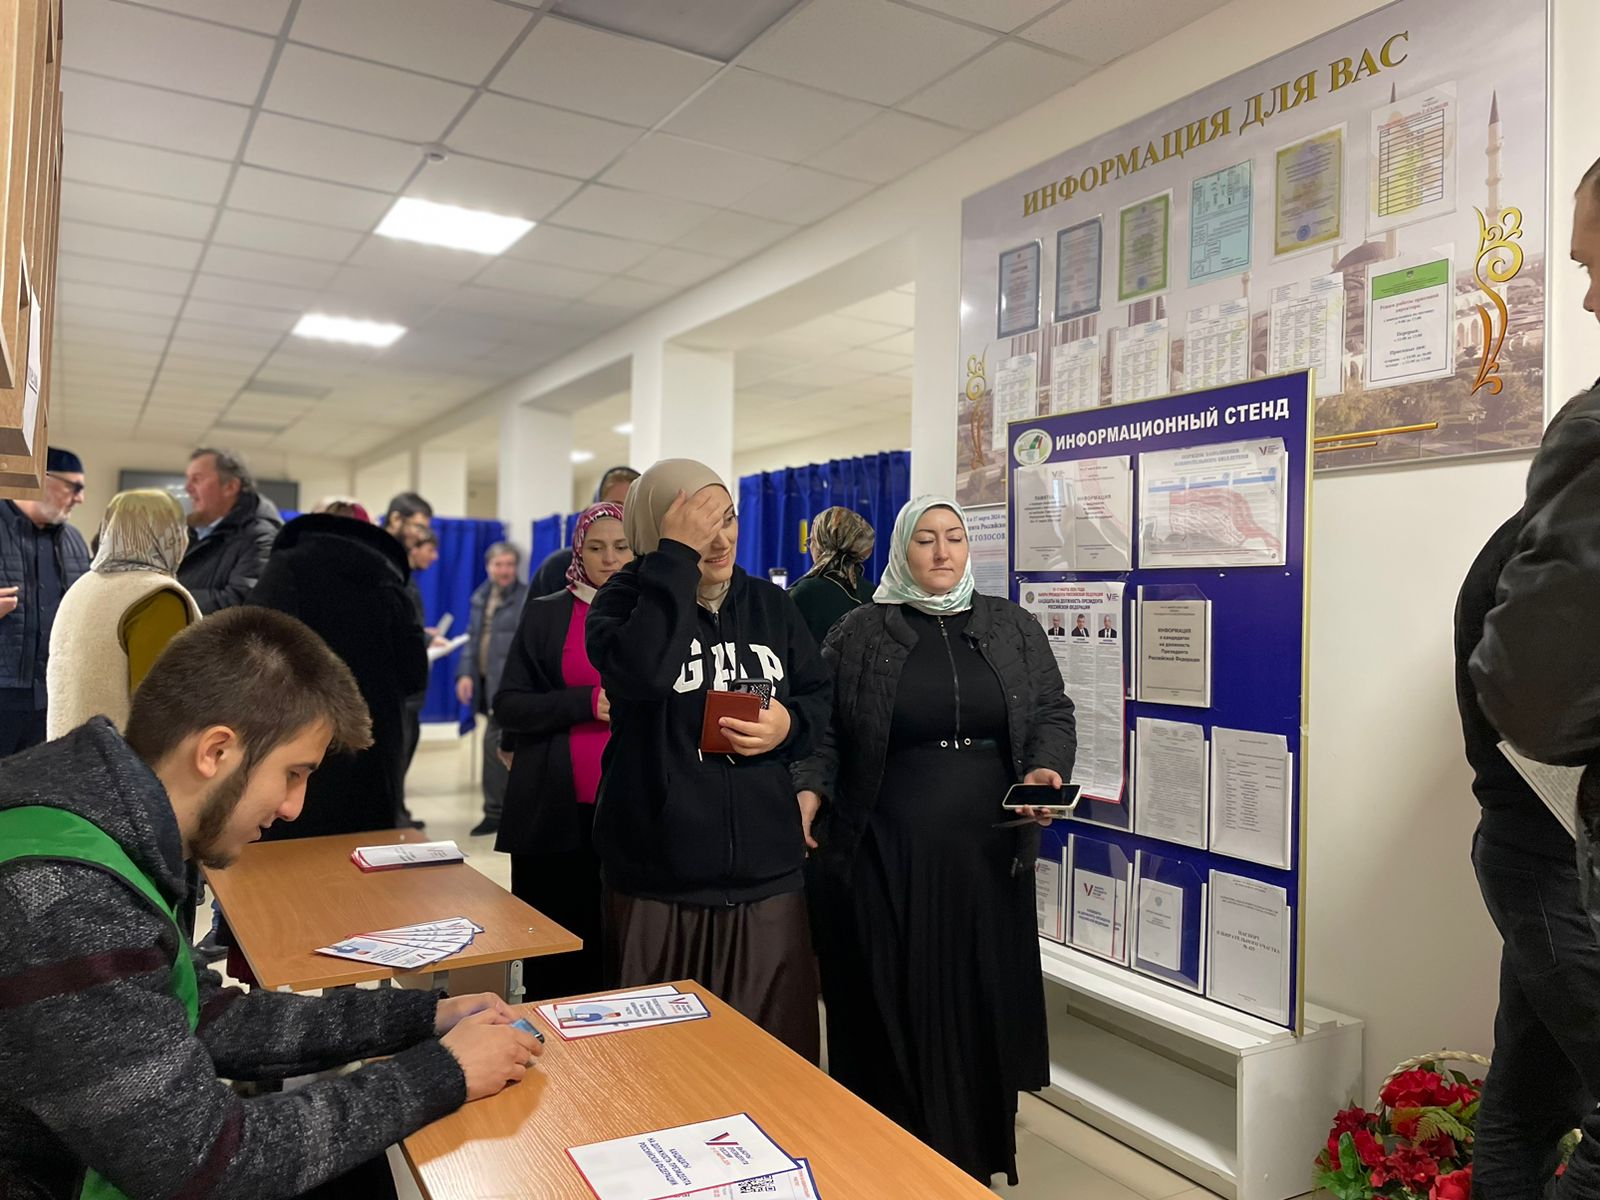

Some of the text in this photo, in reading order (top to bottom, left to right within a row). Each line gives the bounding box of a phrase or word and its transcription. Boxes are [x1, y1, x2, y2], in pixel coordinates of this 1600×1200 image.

[1022, 107, 1231, 217] ИНФОРМАЦИЯ
[1239, 70, 1317, 136] ДЛЯ
[1328, 30, 1408, 93] ВАС
[1055, 406, 1218, 451] ИНФОРМАЦИОННЫЙ
[1224, 398, 1289, 425] СТЕНД
